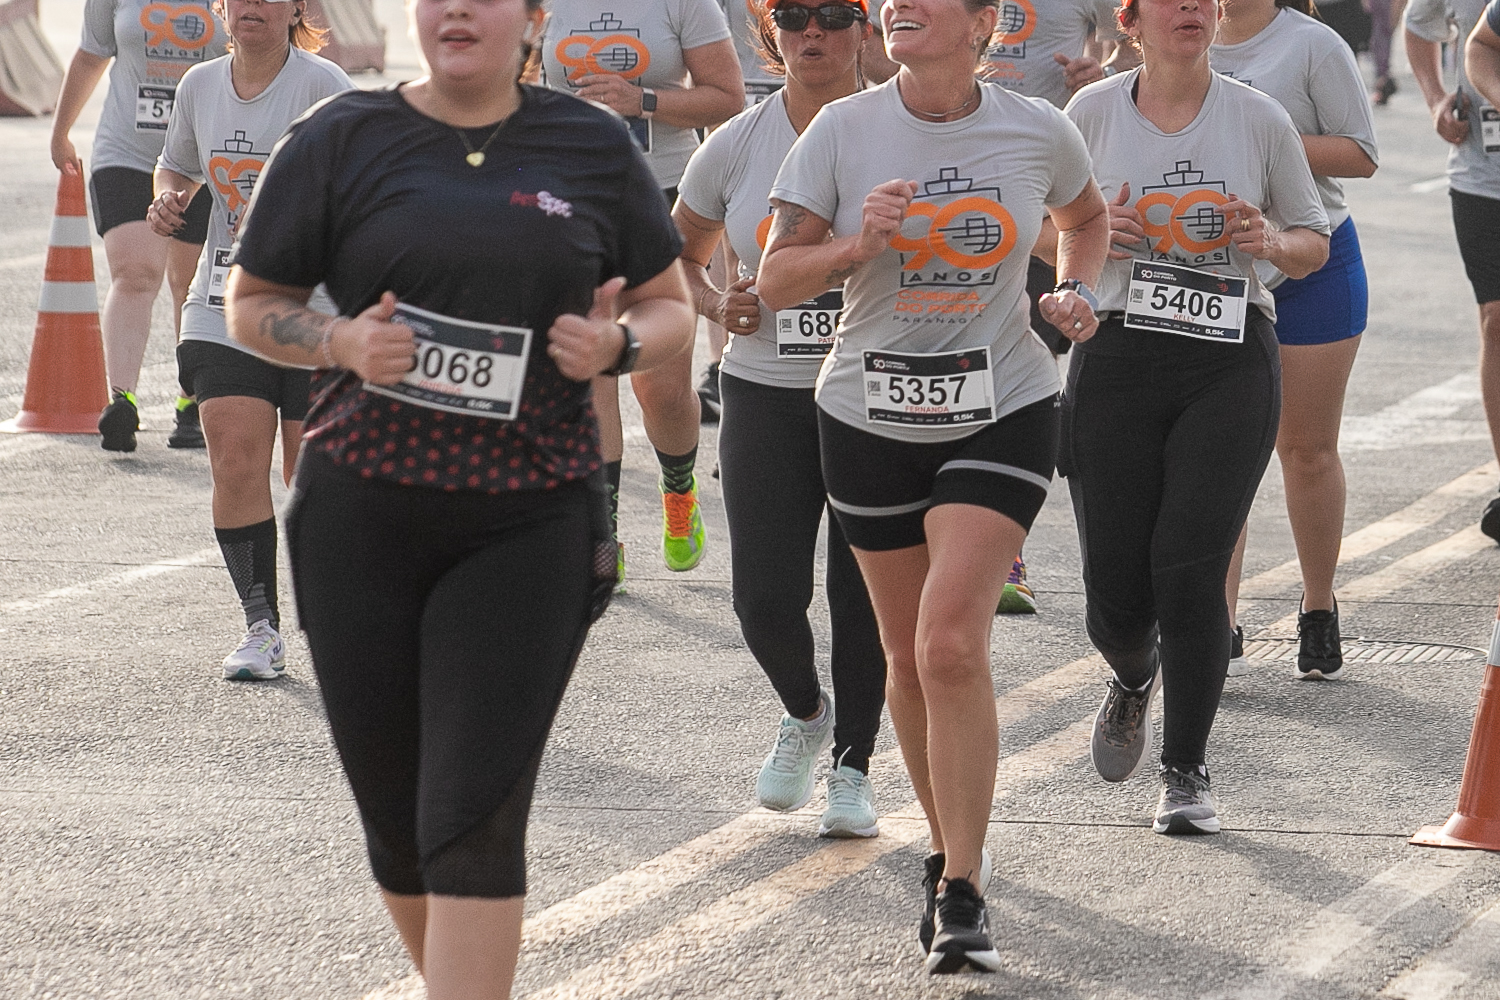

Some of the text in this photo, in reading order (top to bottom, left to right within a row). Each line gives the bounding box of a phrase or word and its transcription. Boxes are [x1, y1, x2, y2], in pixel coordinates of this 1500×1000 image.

[151, 49, 200, 57] ANOS
[1134, 189, 1237, 254] 90
[889, 196, 1018, 270] 90
[1157, 252, 1224, 264] ANOS
[908, 272, 992, 282] ANOS
[897, 289, 980, 301] CORRIDA
[894, 302, 923, 313] DO
[1150, 285, 1223, 320] 5406
[1173, 313, 1196, 323] KELLY
[888, 375, 967, 406] 5357
[904, 405, 950, 413] FERNANDA
